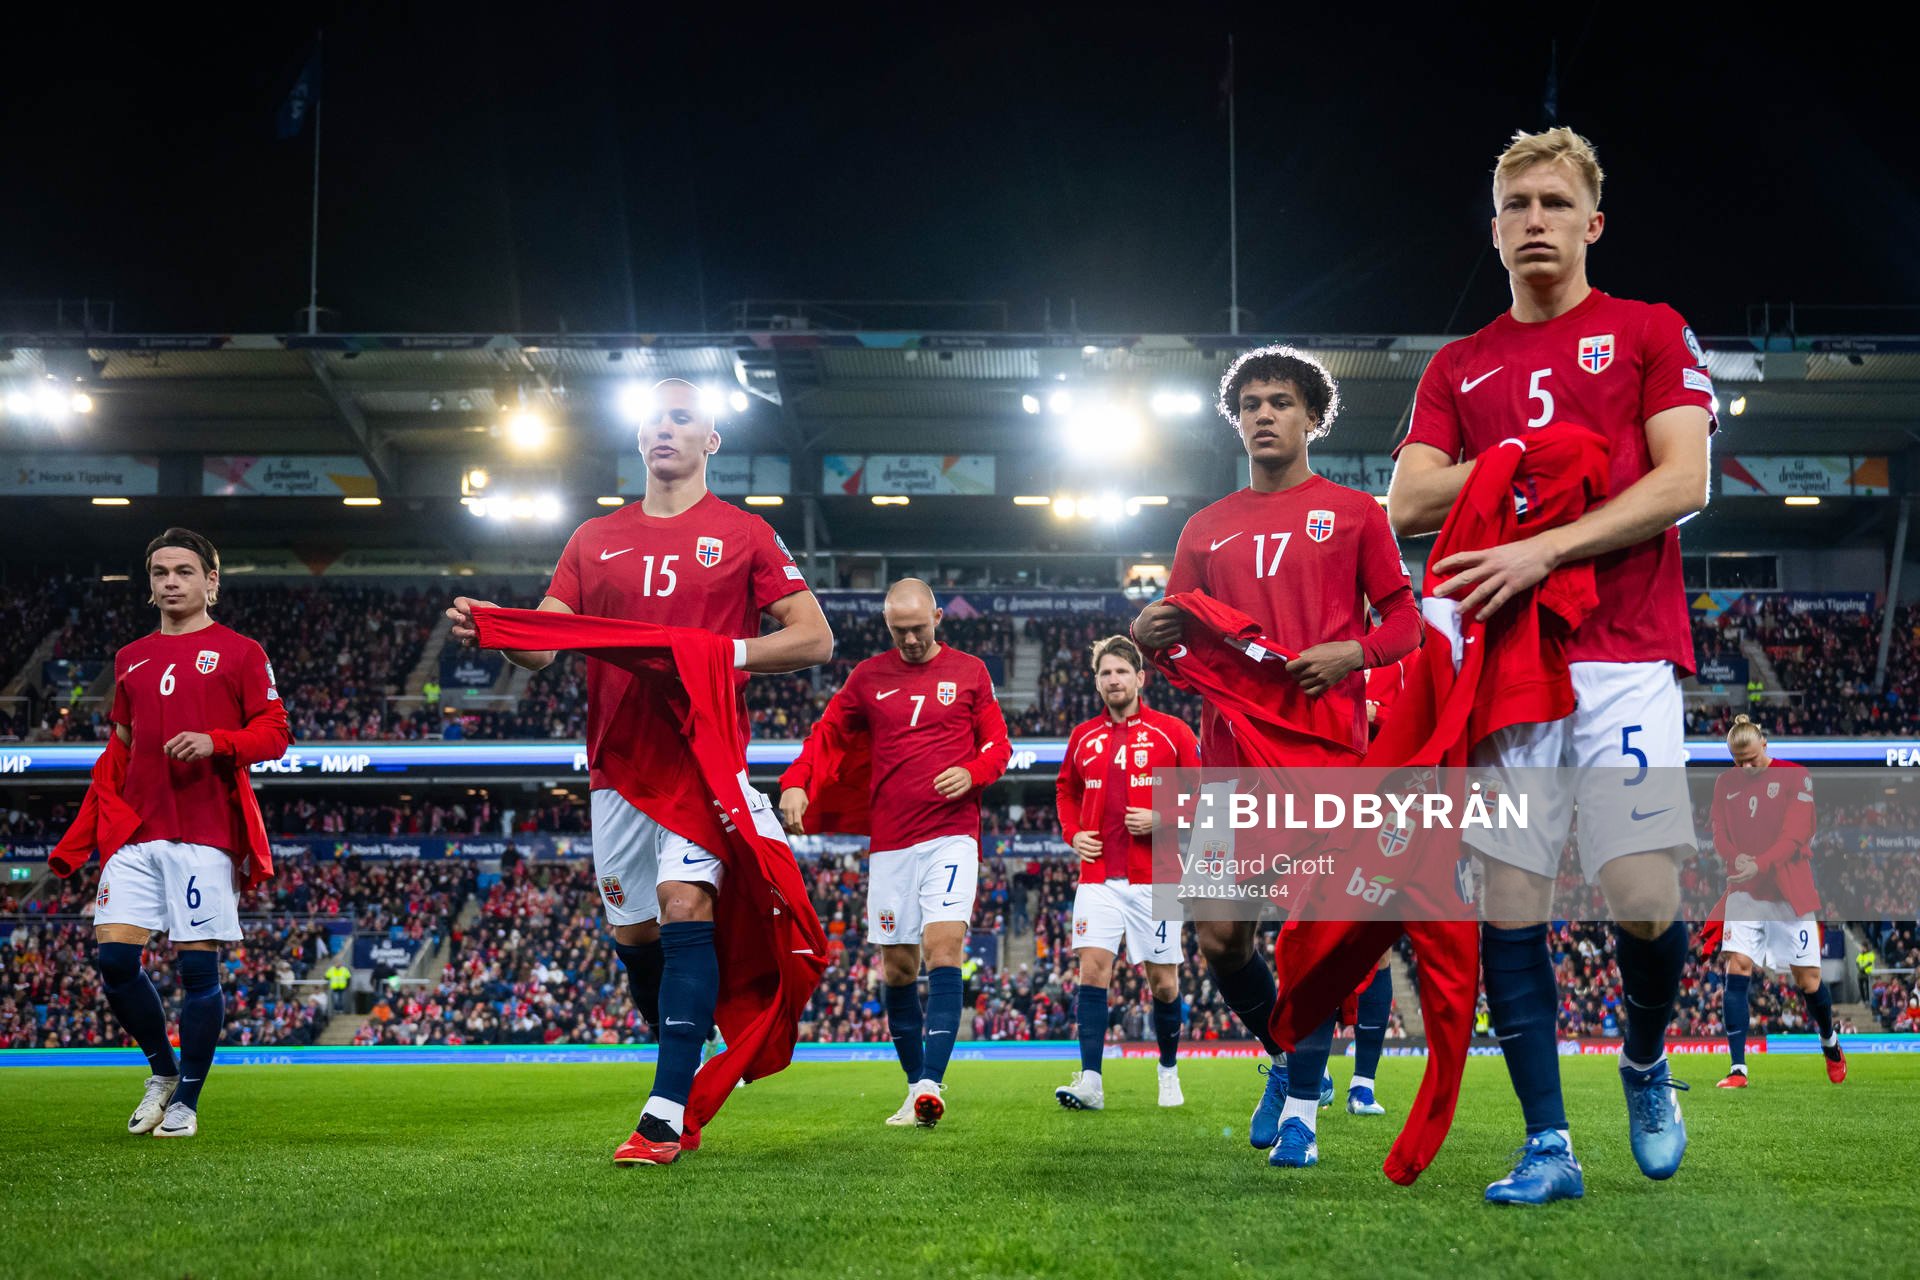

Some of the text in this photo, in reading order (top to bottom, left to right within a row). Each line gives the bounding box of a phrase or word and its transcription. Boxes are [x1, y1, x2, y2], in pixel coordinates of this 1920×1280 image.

[1527, 367, 1555, 428] 5
[1252, 531, 1293, 579] 17
[642, 555, 680, 598] 15
[1793, 598, 1866, 613] Norsk Tipping
[159, 663, 177, 695] 6
[909, 695, 926, 727] 7
[0, 755, 31, 773] ИР
[1113, 744, 1127, 771] 4
[1621, 724, 1649, 786] 5
[1748, 795, 1759, 819] 9
[1876, 836, 1905, 848] Norsk
[186, 875, 202, 910] 6
[944, 864, 959, 893] 7
[1154, 920, 1167, 944] 4
[1799, 929, 1809, 951] 9
